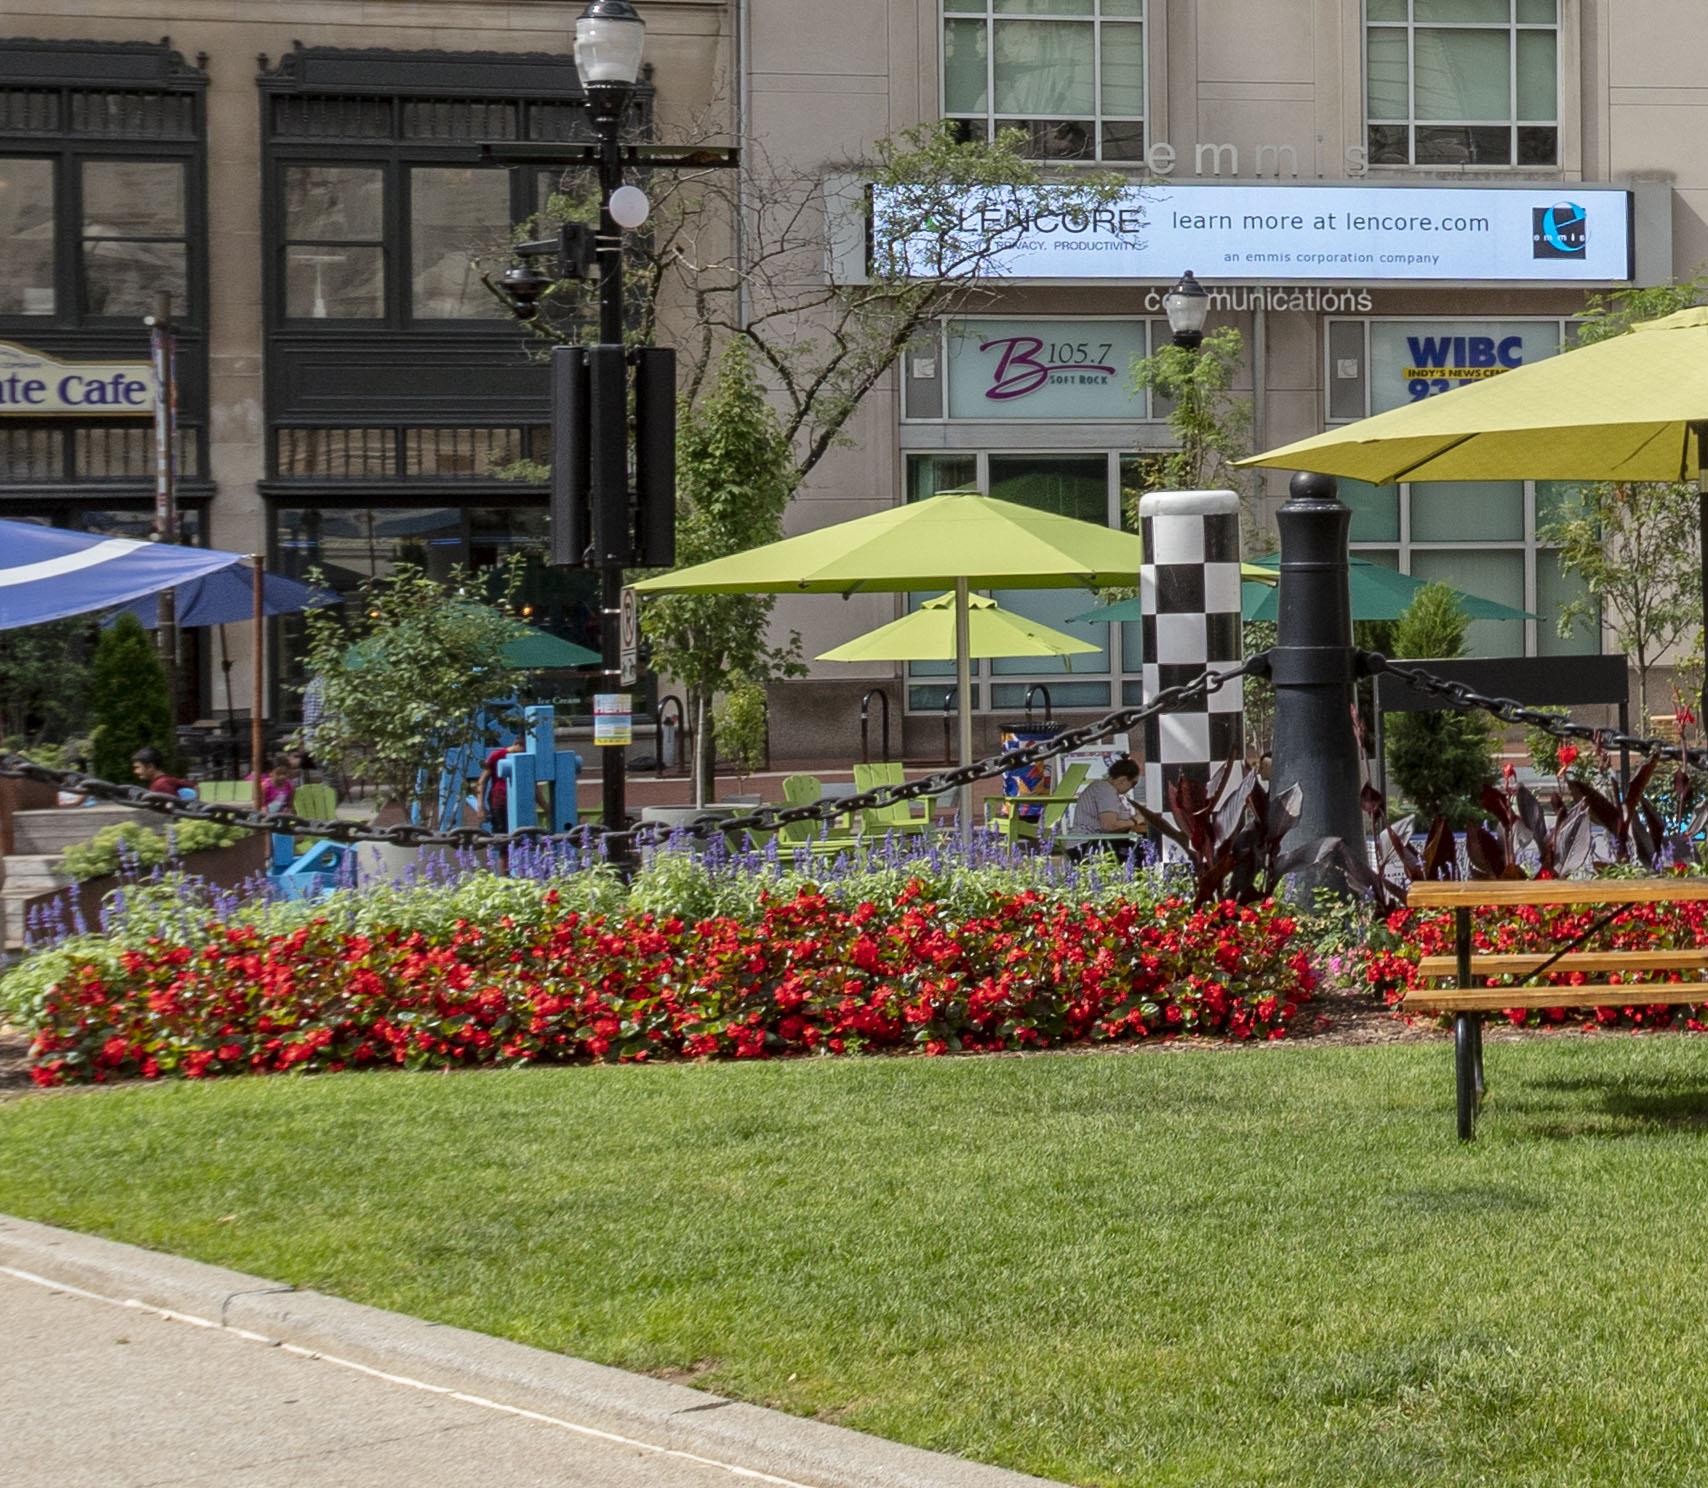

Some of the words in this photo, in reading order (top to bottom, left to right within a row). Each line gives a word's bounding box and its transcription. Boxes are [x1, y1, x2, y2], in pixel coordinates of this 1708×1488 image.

[1149, 141, 1369, 178] emmis
[960, 208, 1141, 234] LENCORE
[1172, 211, 1232, 229] learn
[1243, 214, 1304, 230] more
[1313, 212, 1337, 230] at
[1346, 212, 1489, 232] lencore.com
[1224, 253, 1240, 263] an
[1246, 252, 1292, 263] emmis
[1296, 252, 1374, 265] corporation
[1379, 253, 1440, 265] company
[1143, 287, 1373, 312] cmunications
[1048, 342, 1113, 365] 105.7
[1406, 336, 1523, 369] WIBC
[1050, 375, 1076, 385] SOFT
[1079, 375, 1108, 385] ROCK
[1408, 369, 1446, 378] INDY'S
[1448, 369, 1482, 378] NEWS
[1483, 369, 1511, 378] CEN
[0, 372, 47, 404] te
[57, 373, 147, 405] Cafe
